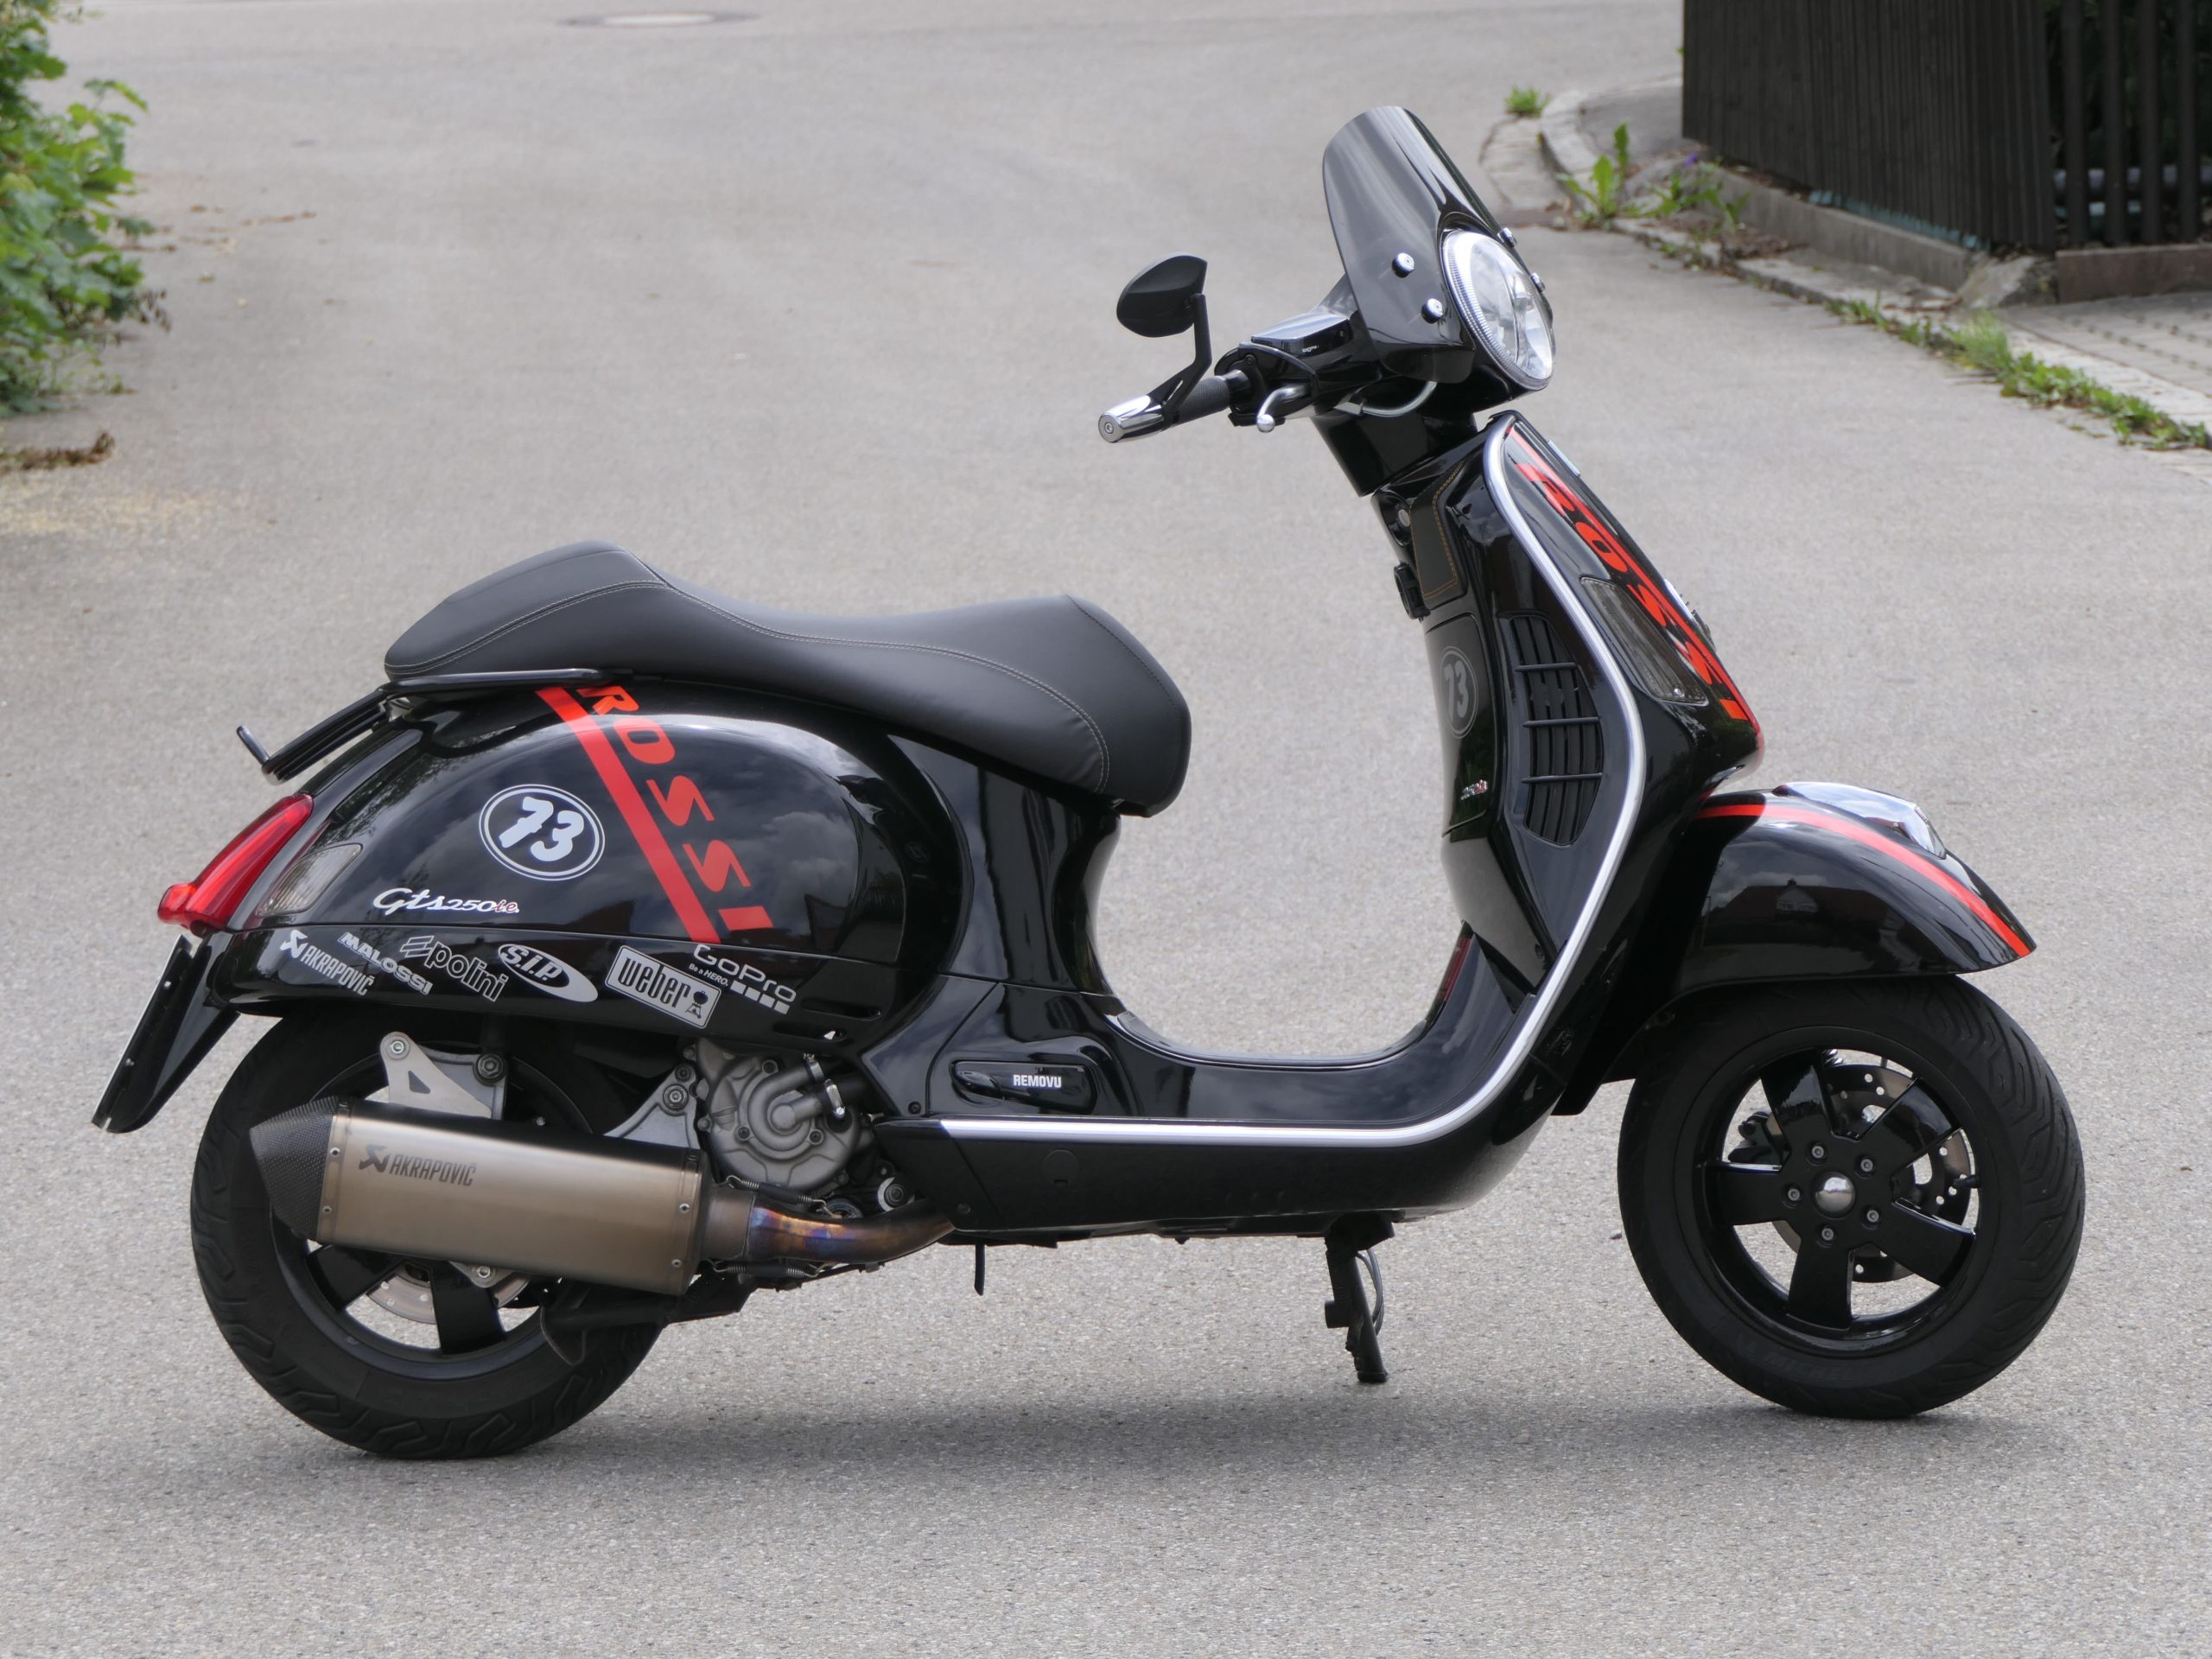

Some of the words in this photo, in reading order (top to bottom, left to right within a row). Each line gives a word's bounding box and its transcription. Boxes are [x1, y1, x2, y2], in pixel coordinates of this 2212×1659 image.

[1443, 660, 1469, 722] 73
[499, 796, 584, 862] 73
[576, 686, 773, 931] ROSSI
[338, 932, 433, 995] MALOSSI
[689, 963, 697, 972] Be
[693, 944, 797, 1002] GoPro
[1014, 1074, 1061, 1088] REMOVU
